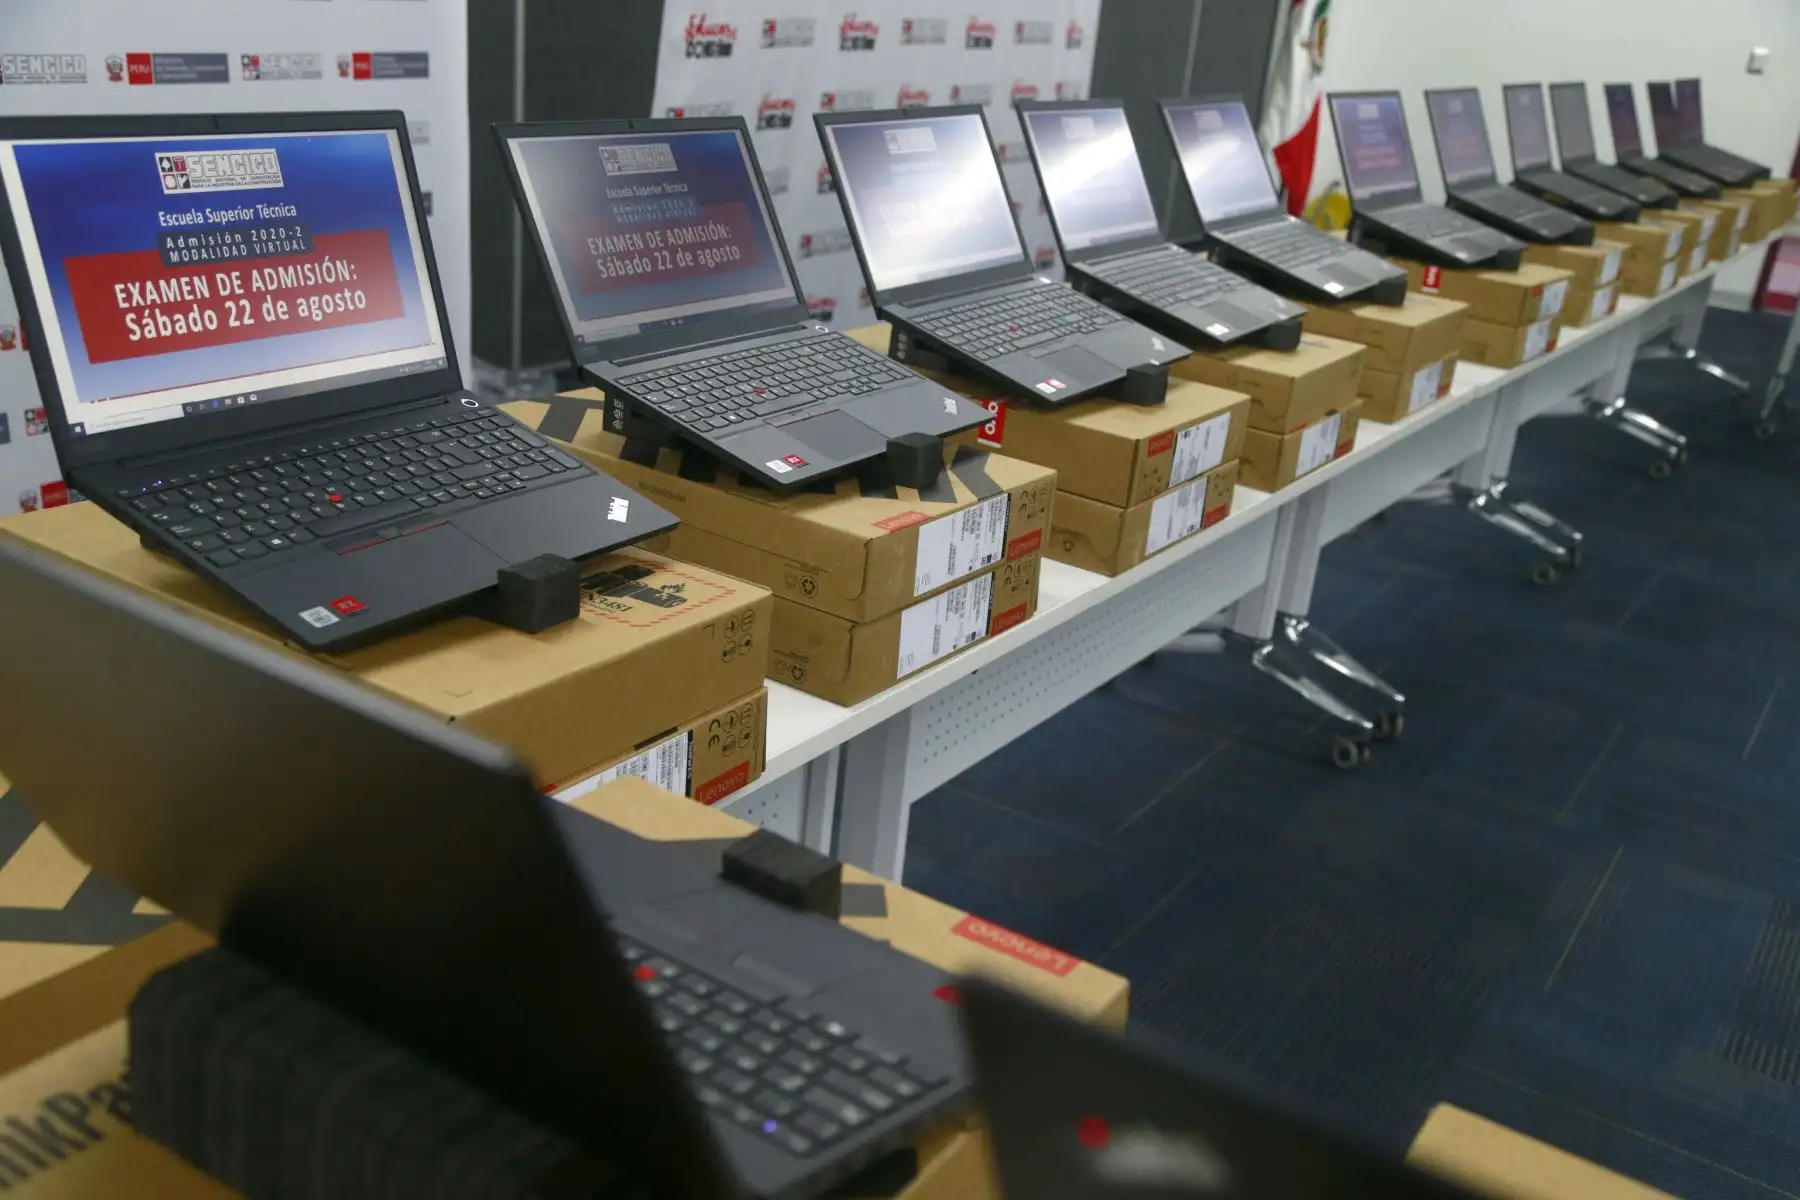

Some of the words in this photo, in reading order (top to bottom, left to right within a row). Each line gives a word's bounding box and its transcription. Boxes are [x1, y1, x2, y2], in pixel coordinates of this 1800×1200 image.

[2, 54, 86, 75] SENCICO
[186, 153, 279, 178] SENCICO
[158, 208, 204, 227] Escuela
[206, 205, 254, 225] Superior
[256, 202, 297, 219] Técnica
[166, 232, 242, 249] Admisión
[251, 226, 303, 241] 2020-2
[169, 245, 248, 263] MODALIDAD
[254, 239, 306, 254] VIRTUAL
[588, 231, 644, 255] EXAMEN
[646, 230, 665, 249] DE
[666, 220, 733, 247] ADMISIÓN:
[597, 252, 652, 279] Sábado
[654, 250, 673, 271] 22
[676, 248, 694, 268] de
[697, 244, 741, 269] agosto
[114, 275, 210, 309] EXAMEN
[216, 272, 245, 297] DE
[252, 255, 358, 293] ADMISIÓN:
[125, 304, 218, 342] Sábado
[225, 298, 255, 328] 22
[262, 295, 289, 322] de
[296, 287, 367, 321] agosto
[699, 772, 745, 802] Lenovo
